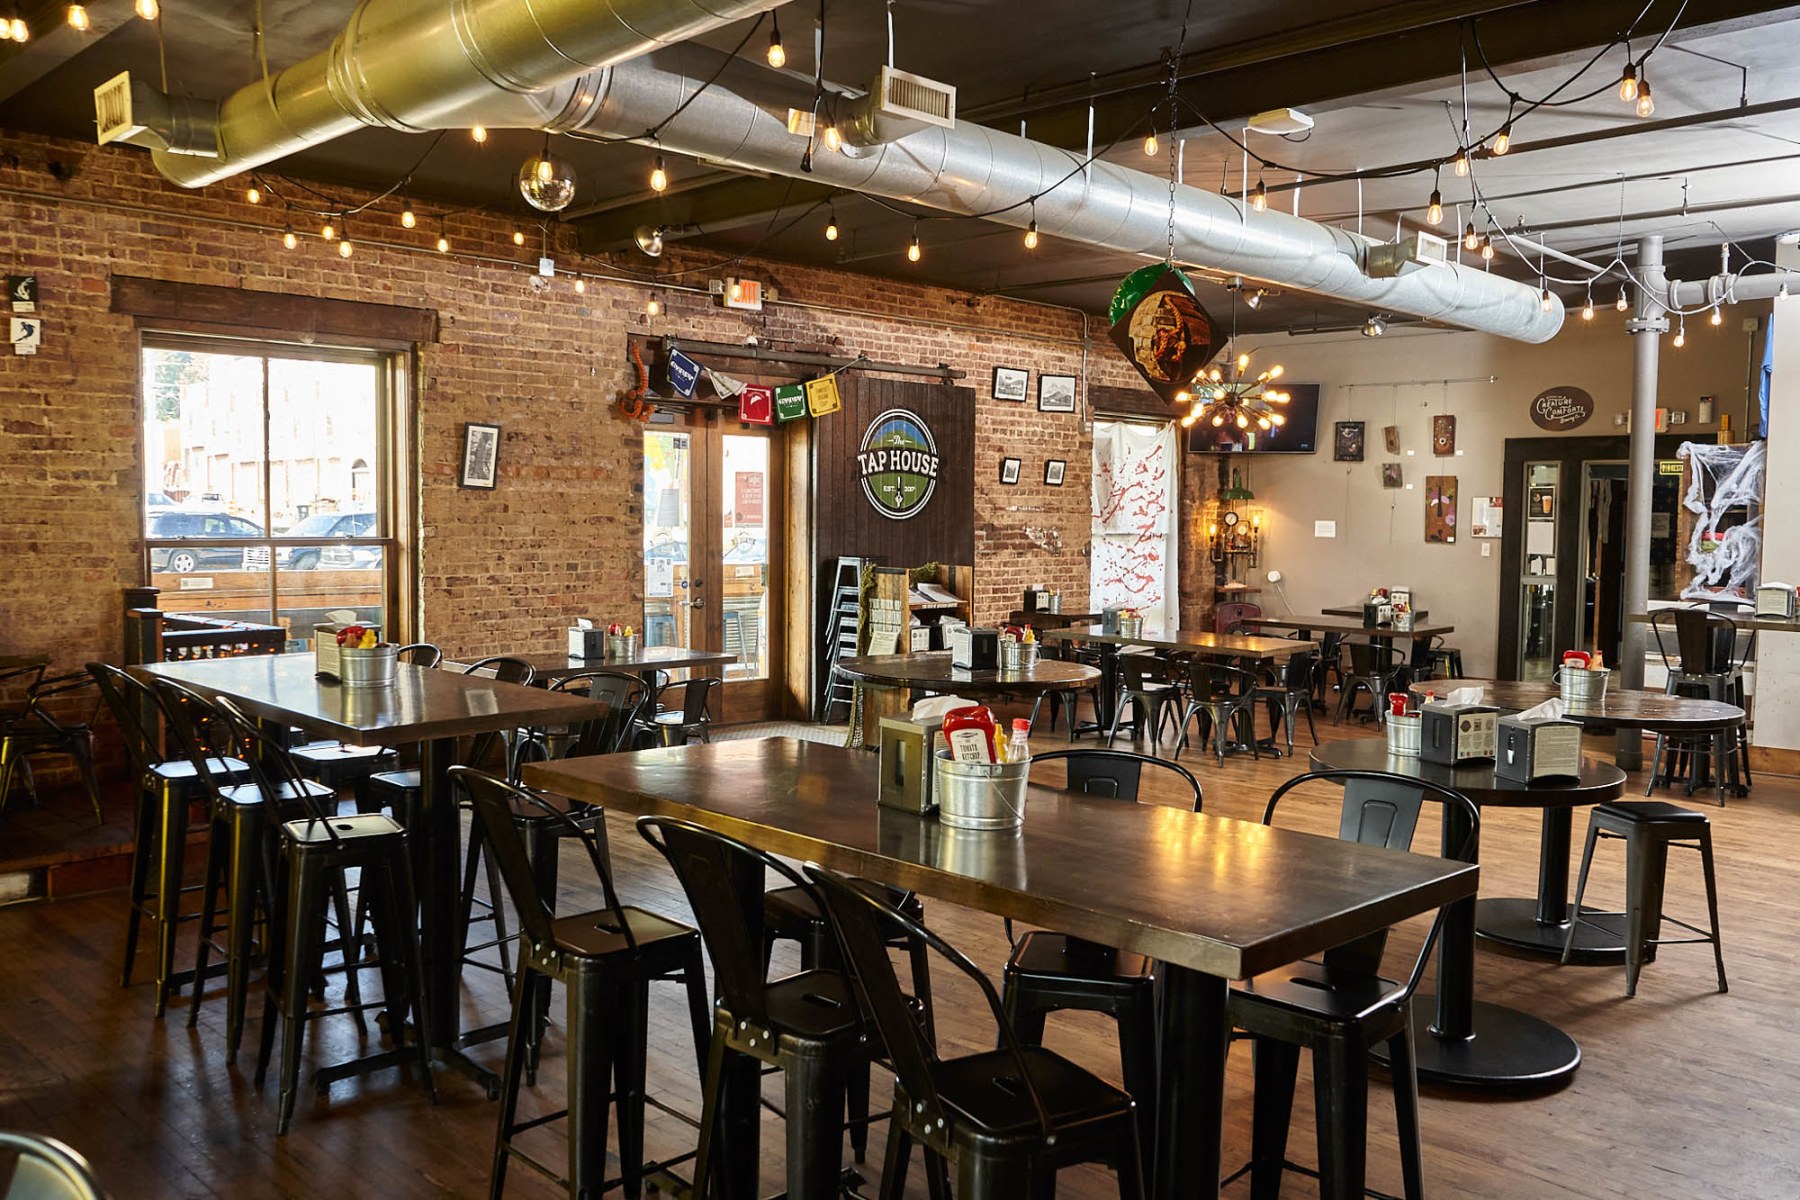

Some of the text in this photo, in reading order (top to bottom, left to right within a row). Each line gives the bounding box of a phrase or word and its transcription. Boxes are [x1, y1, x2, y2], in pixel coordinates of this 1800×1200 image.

[732, 281, 758, 304] XIT
[1536, 397, 1572, 414] CREATURE
[1545, 405, 1585, 420] COMFORTS
[893, 435, 905, 445] The
[857, 450, 939, 477] TAP HOUSE
[960, 743, 978, 752] TOMATO
